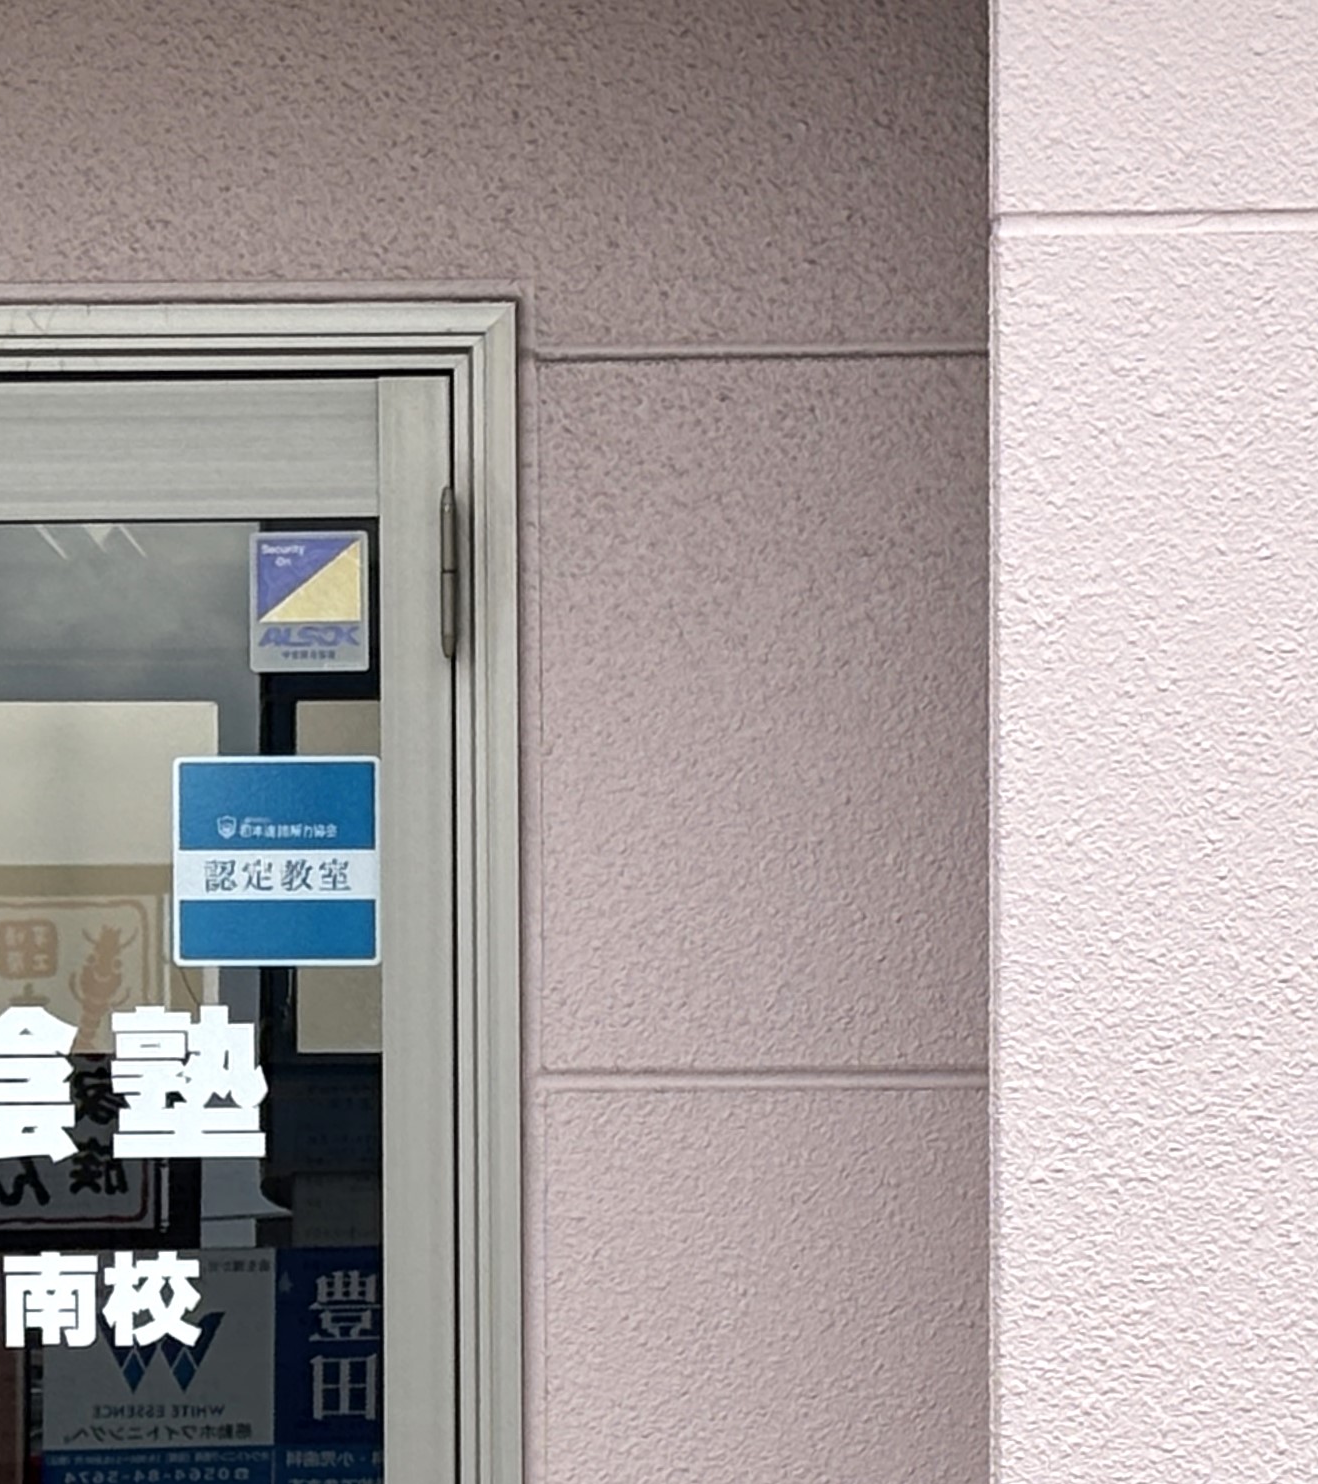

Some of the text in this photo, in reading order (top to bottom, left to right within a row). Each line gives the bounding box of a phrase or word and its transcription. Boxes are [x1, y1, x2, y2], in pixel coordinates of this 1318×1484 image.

[261, 544, 305, 556] Security
[258, 625, 360, 647] ALSOK
[204, 858, 352, 894] 認定教室
